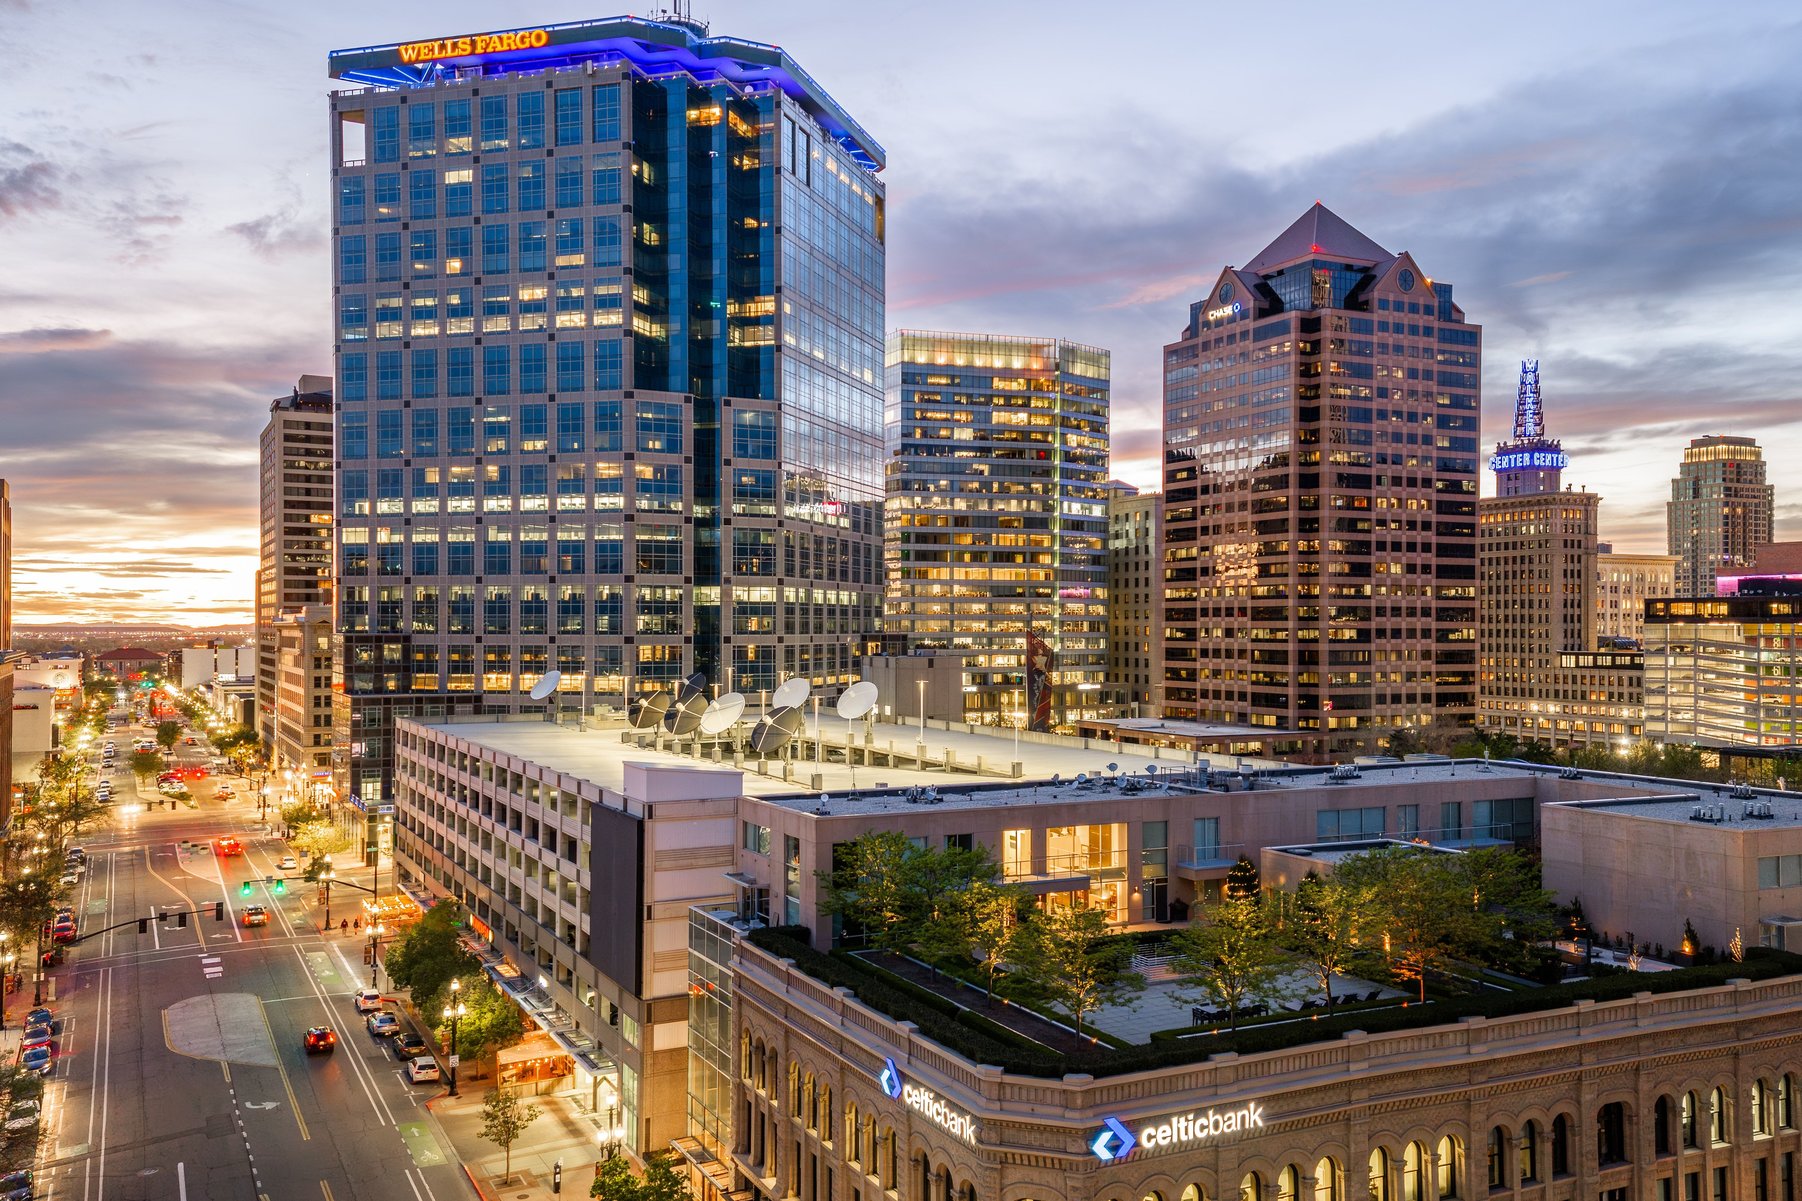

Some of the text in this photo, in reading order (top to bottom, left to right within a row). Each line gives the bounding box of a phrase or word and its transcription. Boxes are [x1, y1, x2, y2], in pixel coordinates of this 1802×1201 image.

[399, 29, 548, 62] WELLS FARGO
[1209, 305, 1233, 320] CHASE
[1525, 359, 1535, 436] WALKER
[1488, 452, 1569, 470] CENTER CENTER
[903, 1084, 976, 1145] celticbank
[1141, 1102, 1263, 1148] celticbank
